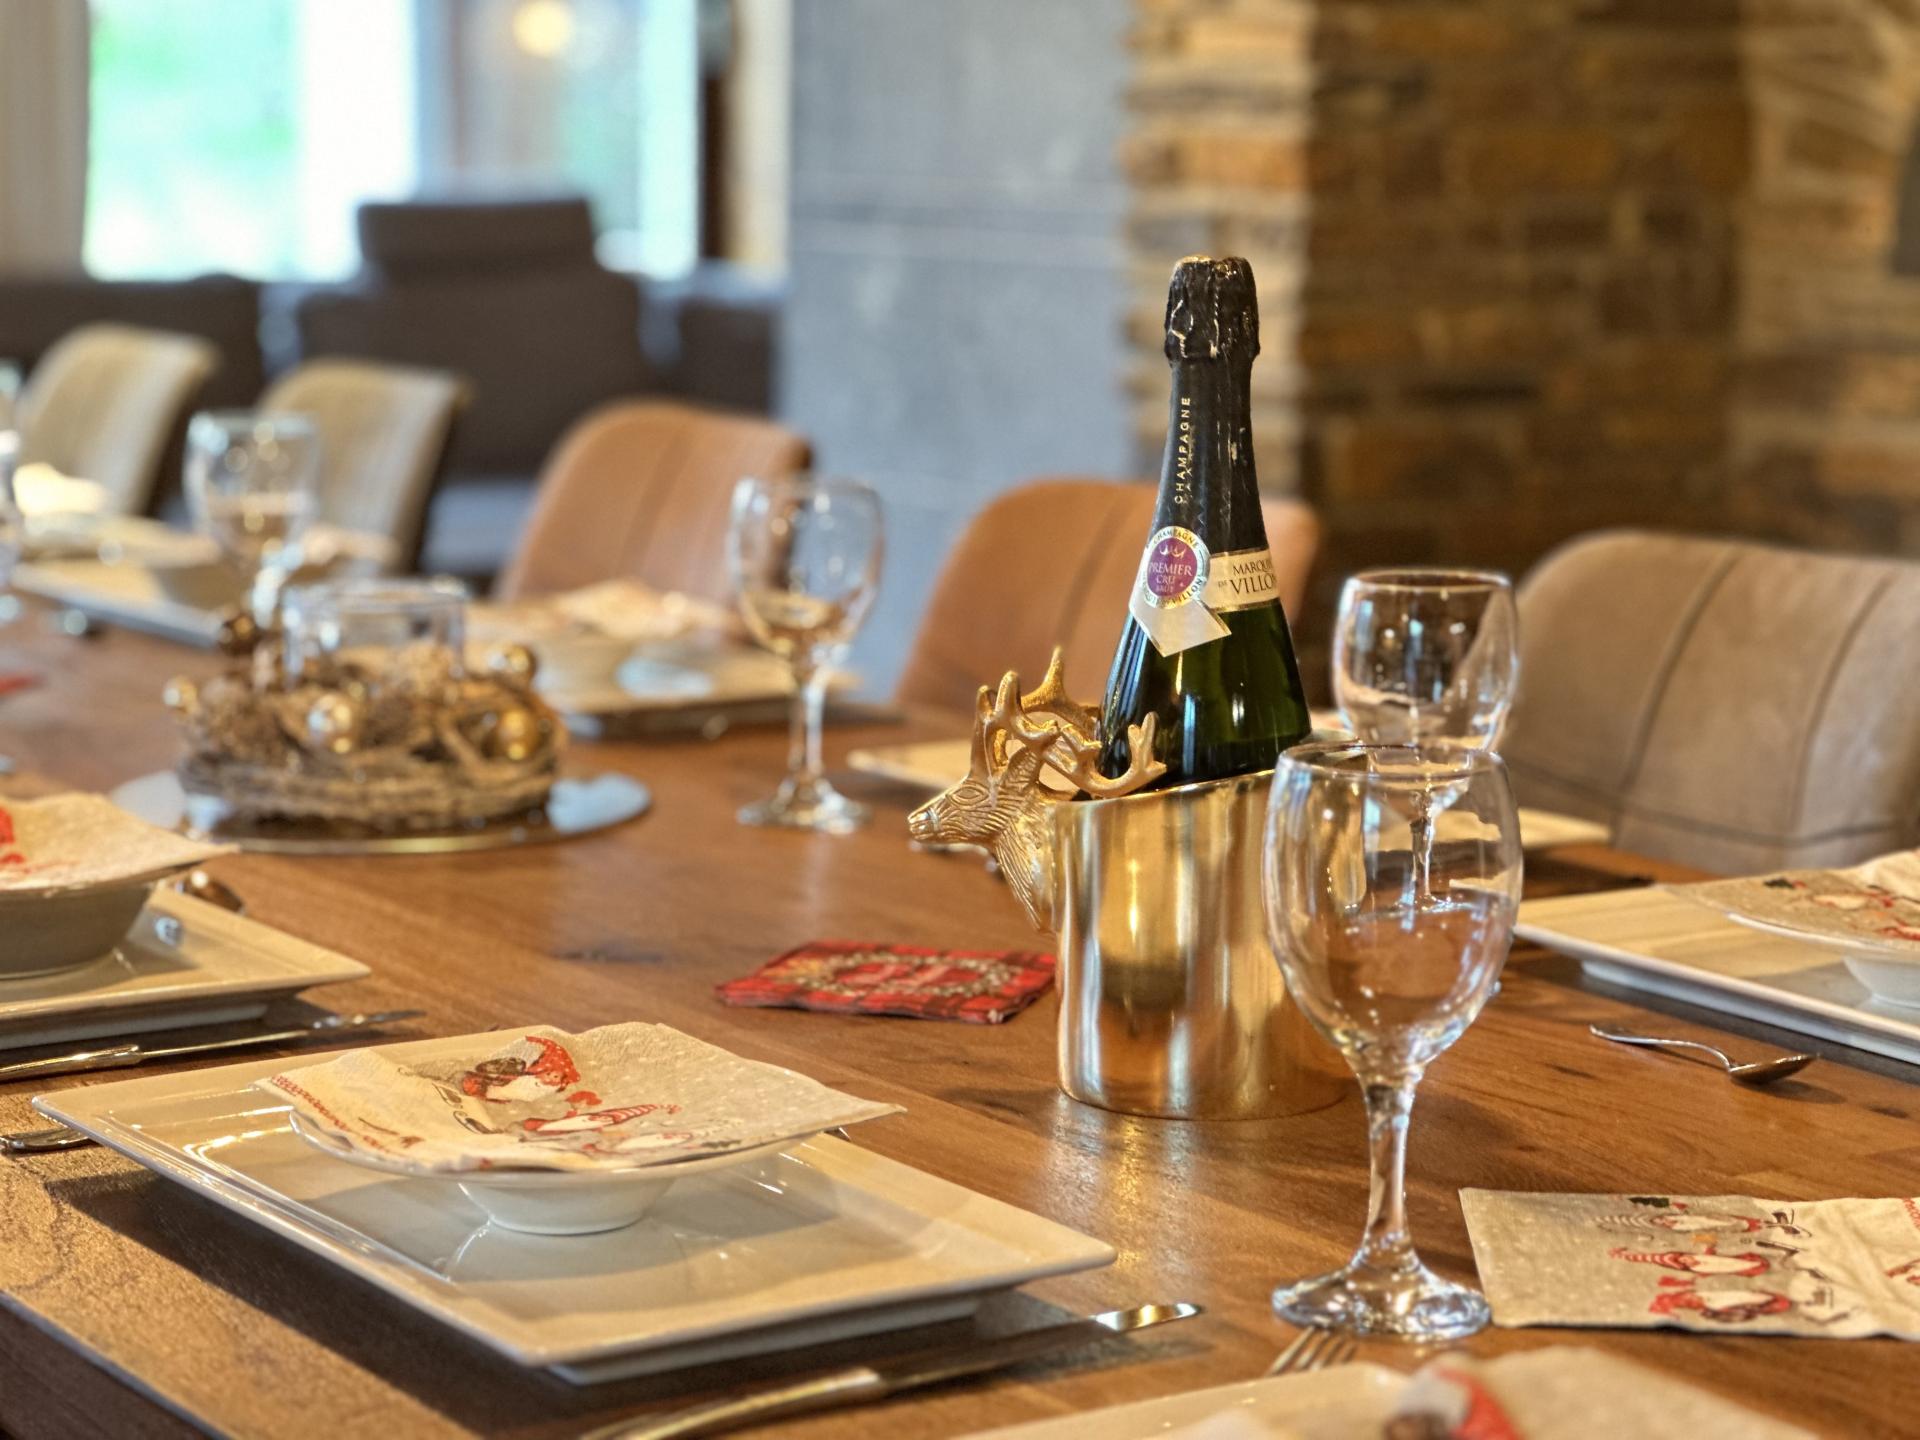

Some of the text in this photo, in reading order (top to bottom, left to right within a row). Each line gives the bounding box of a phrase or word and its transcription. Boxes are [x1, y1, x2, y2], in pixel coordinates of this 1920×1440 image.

[1174, 397, 1191, 504] CHAMPAGNE
[1149, 562, 1193, 577] PREMIER
[1156, 575, 1176, 587] CRU
